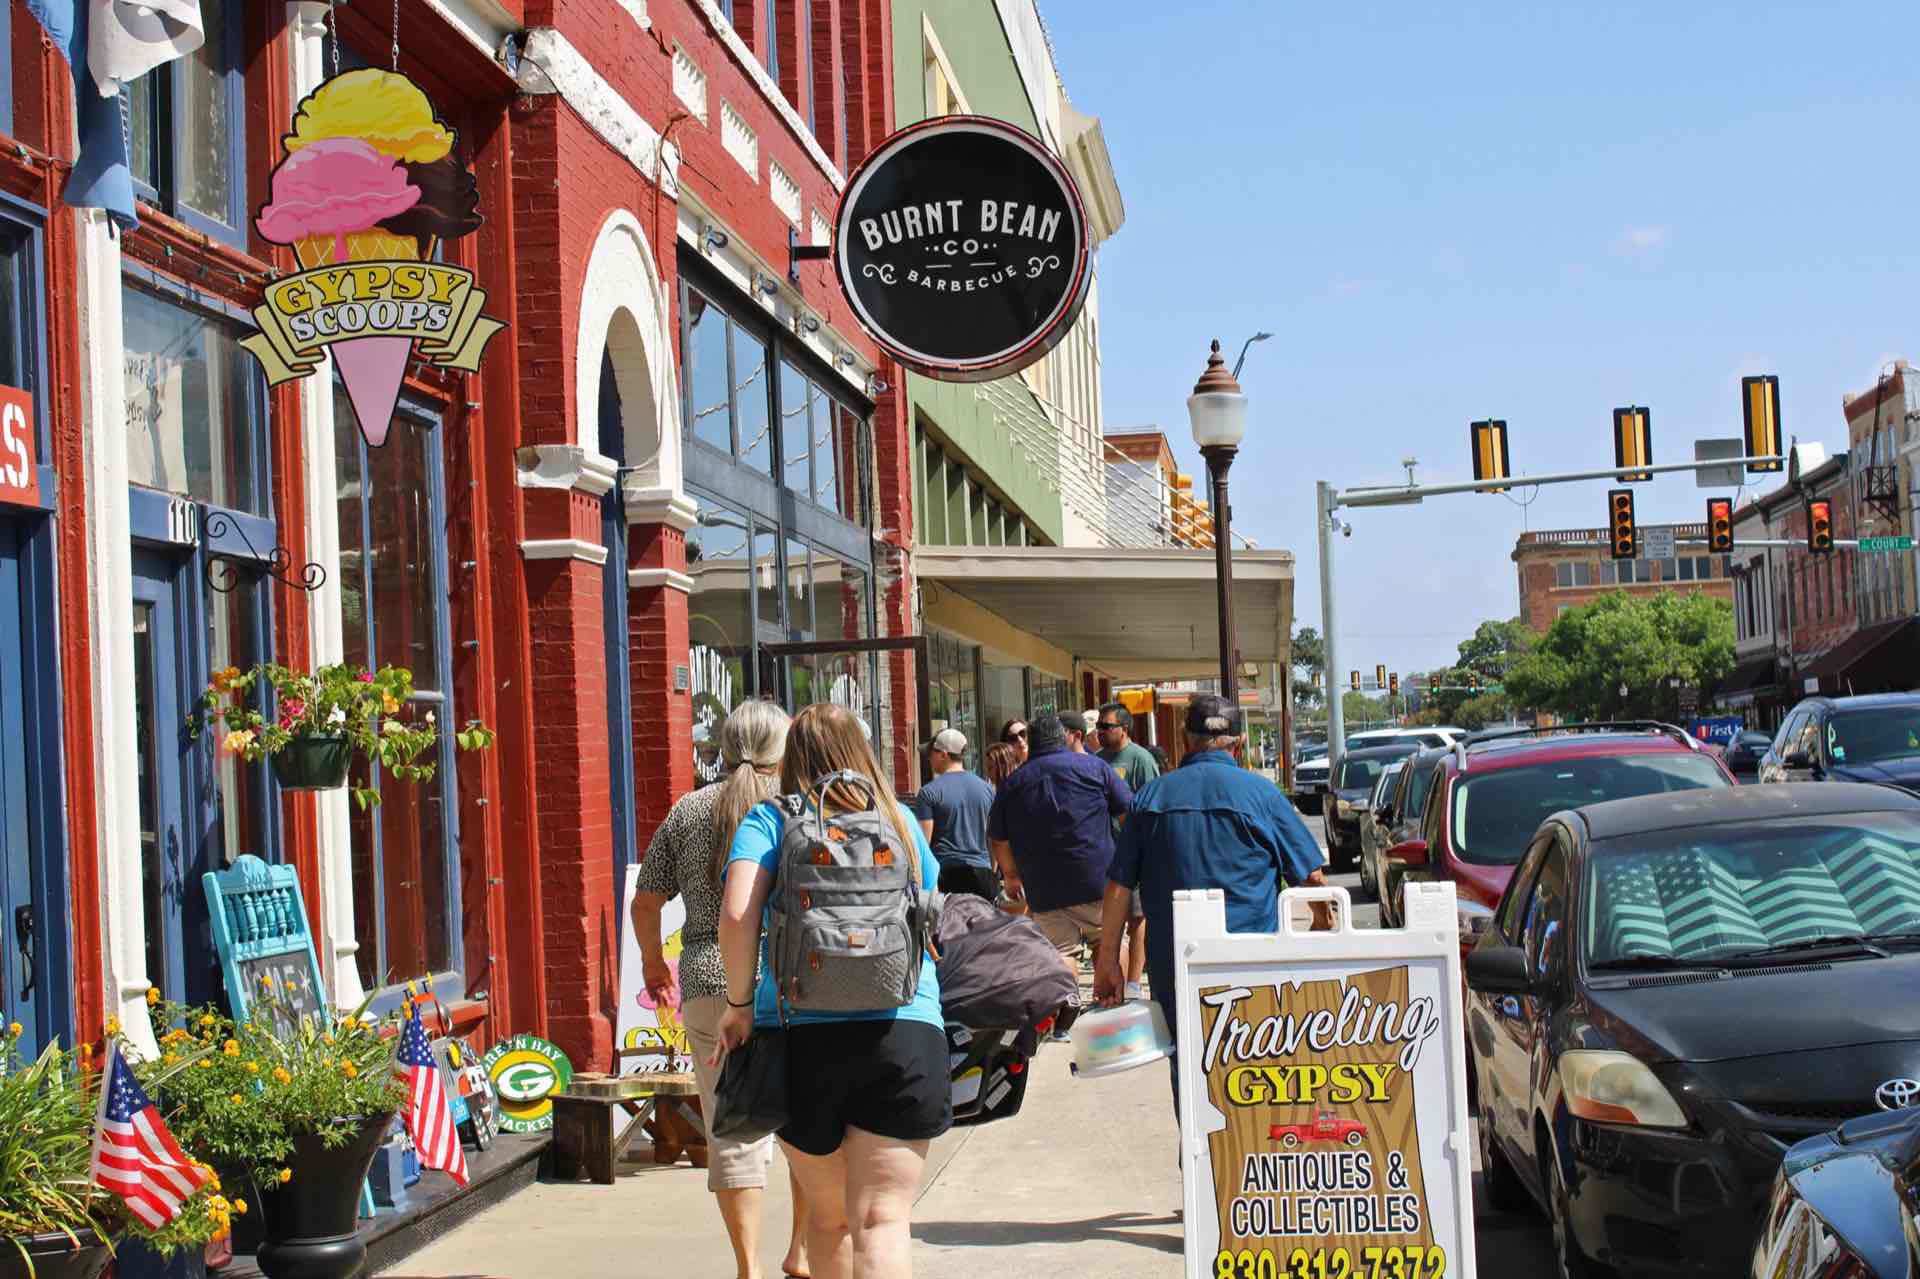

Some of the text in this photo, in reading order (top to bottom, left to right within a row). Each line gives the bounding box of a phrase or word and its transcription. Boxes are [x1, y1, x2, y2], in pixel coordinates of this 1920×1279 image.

[859, 200, 1062, 251] BURNT BEAN
[274, 266, 467, 316] GYPSY
[906, 264, 1018, 292] BARBECUE
[290, 301, 451, 342] SCOOPS
[168, 499, 198, 546] 110
[1202, 985, 1439, 1073] Traveling
[531, 1040, 562, 1061] BAY
[1225, 1063, 1396, 1105] GYPSY
[1242, 1151, 1409, 1194] ANTIQUES &
[1231, 1196, 1420, 1237] COLLECTIBLES
[1215, 1246, 1446, 1279] 830-312-7372
